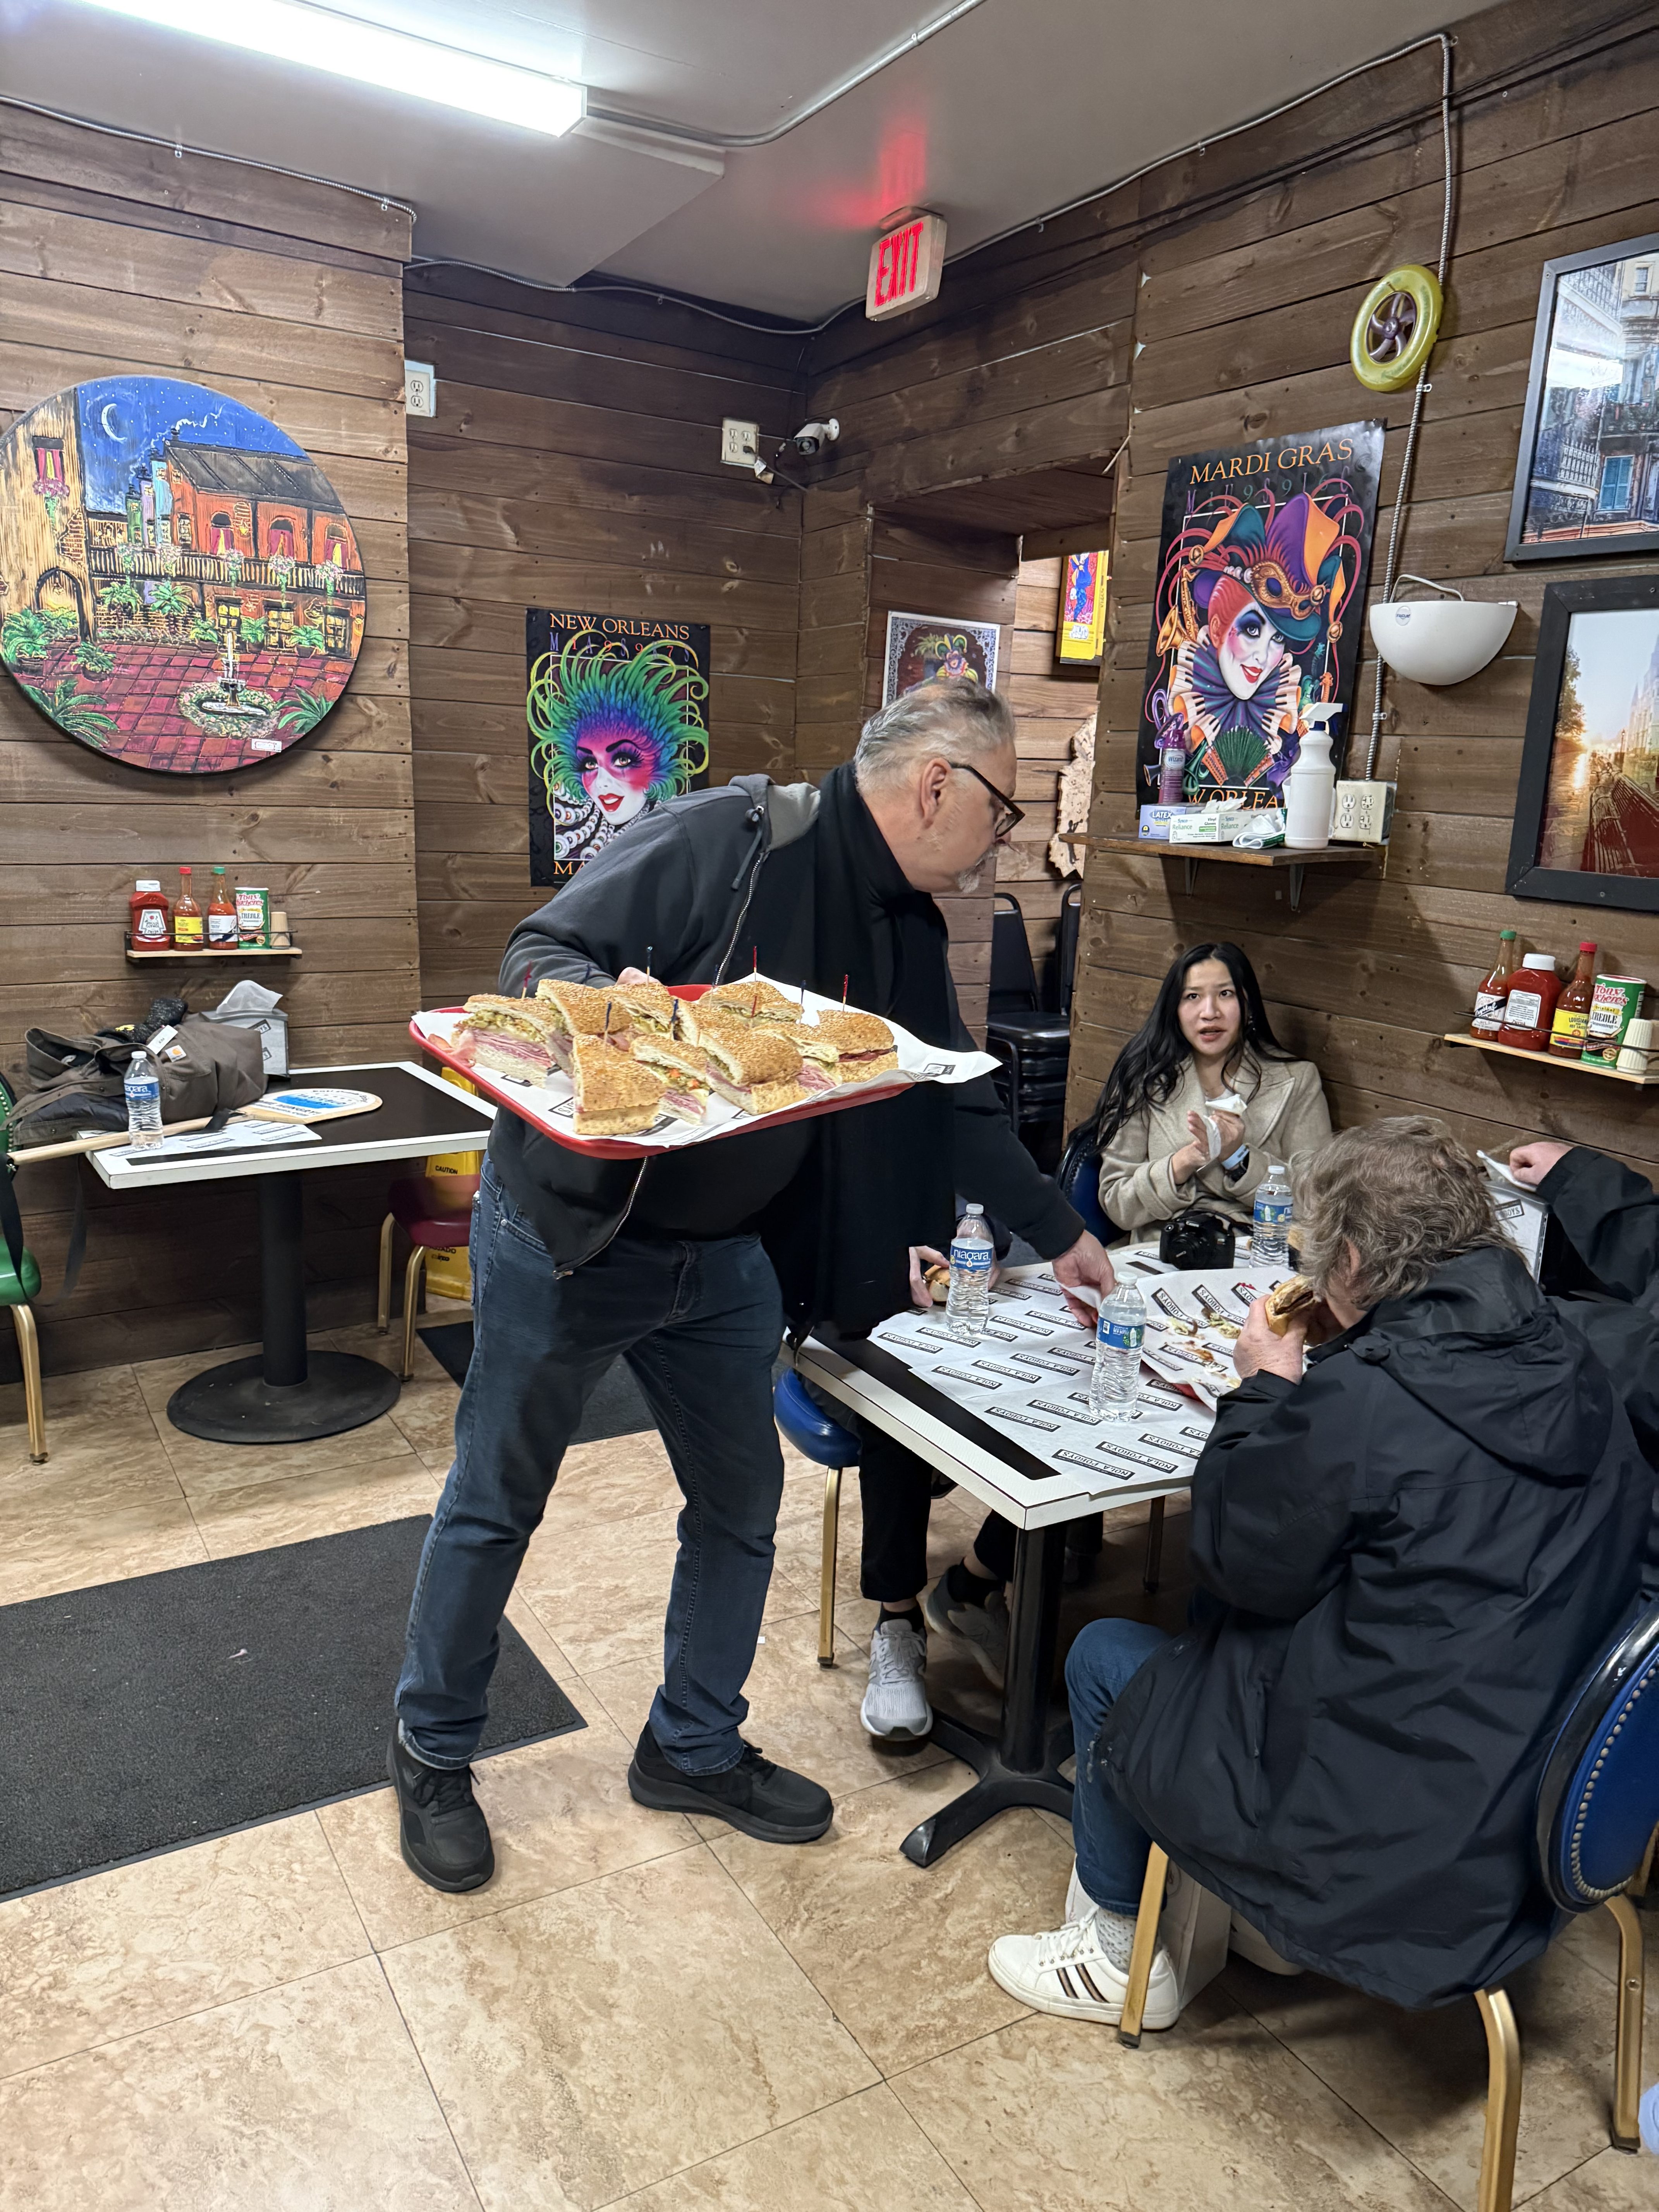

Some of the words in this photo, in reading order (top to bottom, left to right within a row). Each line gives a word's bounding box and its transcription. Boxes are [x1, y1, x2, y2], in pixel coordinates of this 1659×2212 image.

[875, 221, 924, 307] EXIT
[1190, 452, 1271, 484] MARDI
[1278, 438, 1353, 469] GRAS
[550, 613, 597, 631] NEW
[602, 618, 690, 640] ORLEANS
[435, 1165, 458, 1175] CAUTION
[954, 1249, 989, 1264] niagara
[1159, 1292, 1183, 1318] POBOYS
[1152, 1398, 1178, 1410] NOLA
[1106, 1444, 1145, 1460] POBOYS
[1149, 1436, 1187, 1453] POBOYS
[1062, 1451, 1099, 1468] POBOYS
[1146, 1457, 1172, 1470] NOLA
[1103, 1465, 1129, 1477] NOLA
